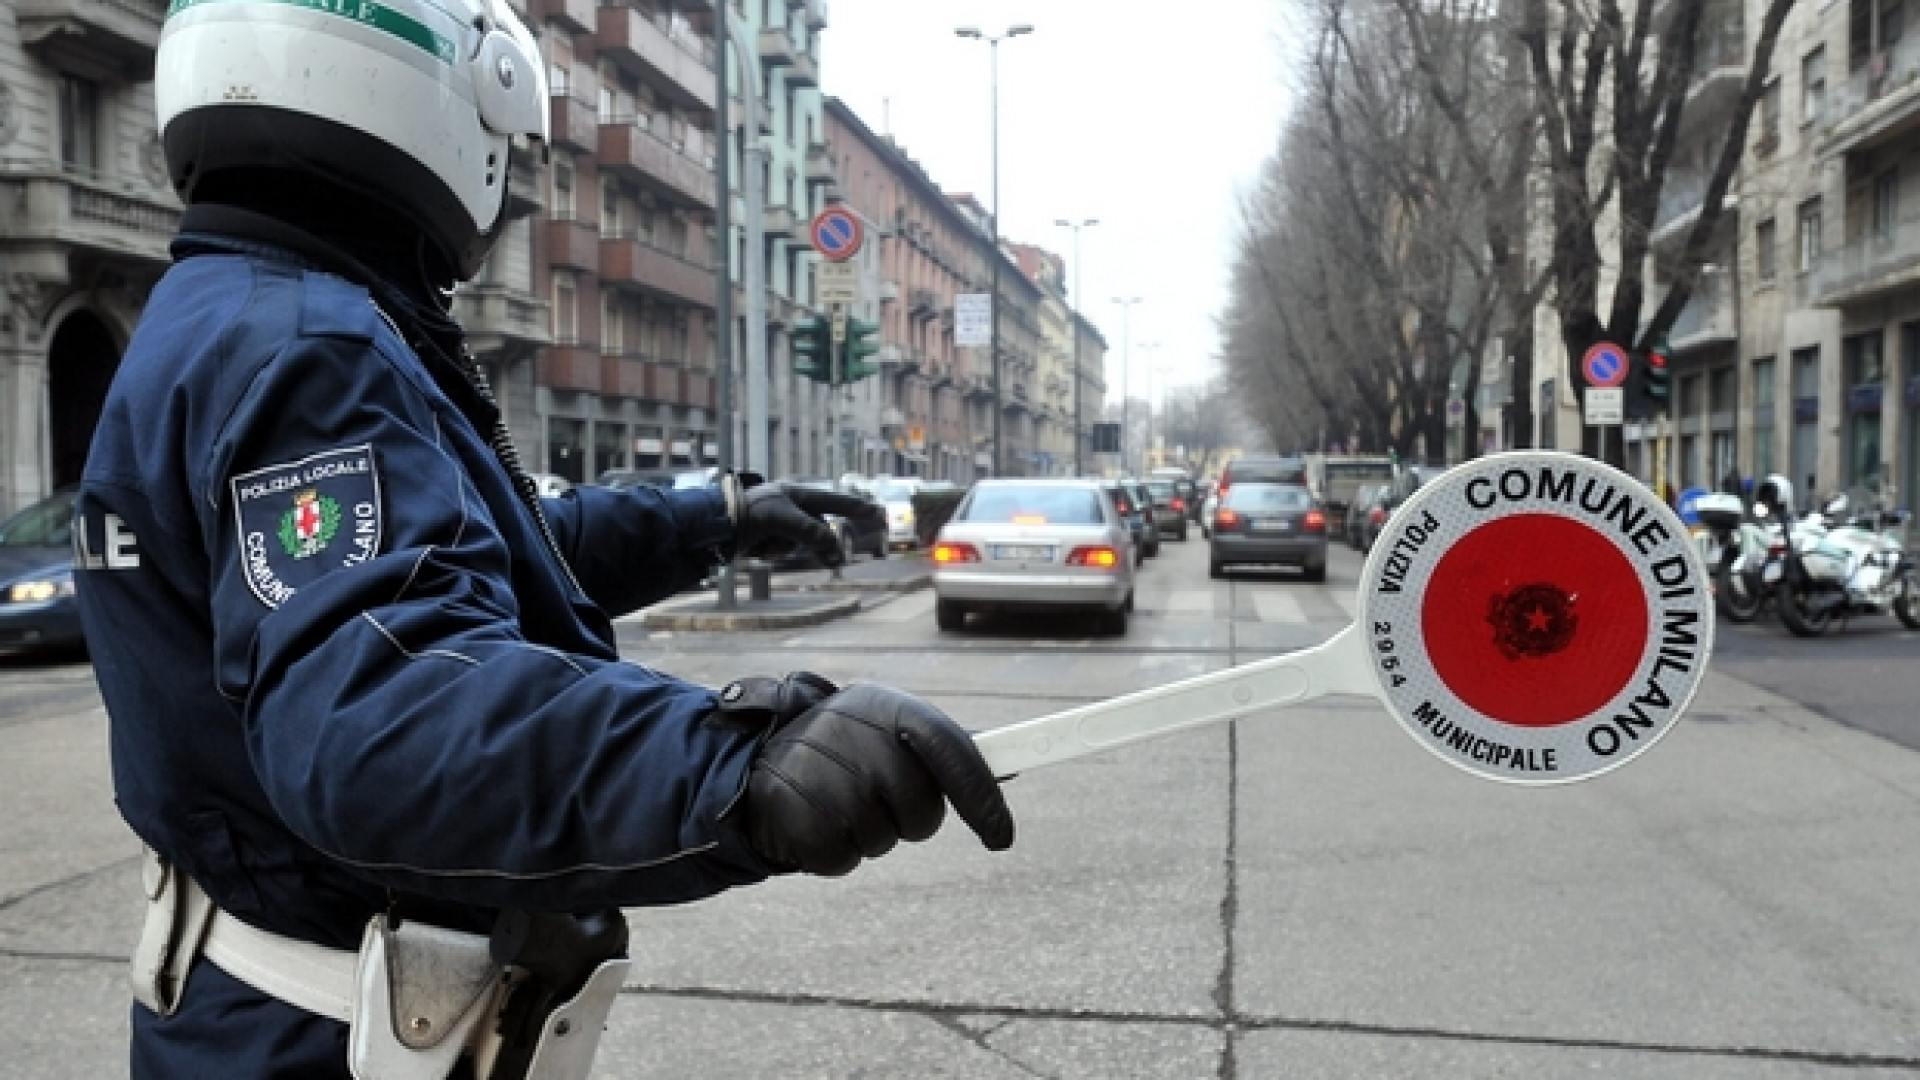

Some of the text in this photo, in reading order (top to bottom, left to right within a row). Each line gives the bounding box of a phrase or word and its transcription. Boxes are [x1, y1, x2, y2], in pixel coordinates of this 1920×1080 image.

[241, 457, 370, 501] POLIZIA LOCALE
[1378, 510, 1558, 772] POLIZIA MUNICIPALE
[1465, 467, 1698, 756] COMUNE DI MILANO
